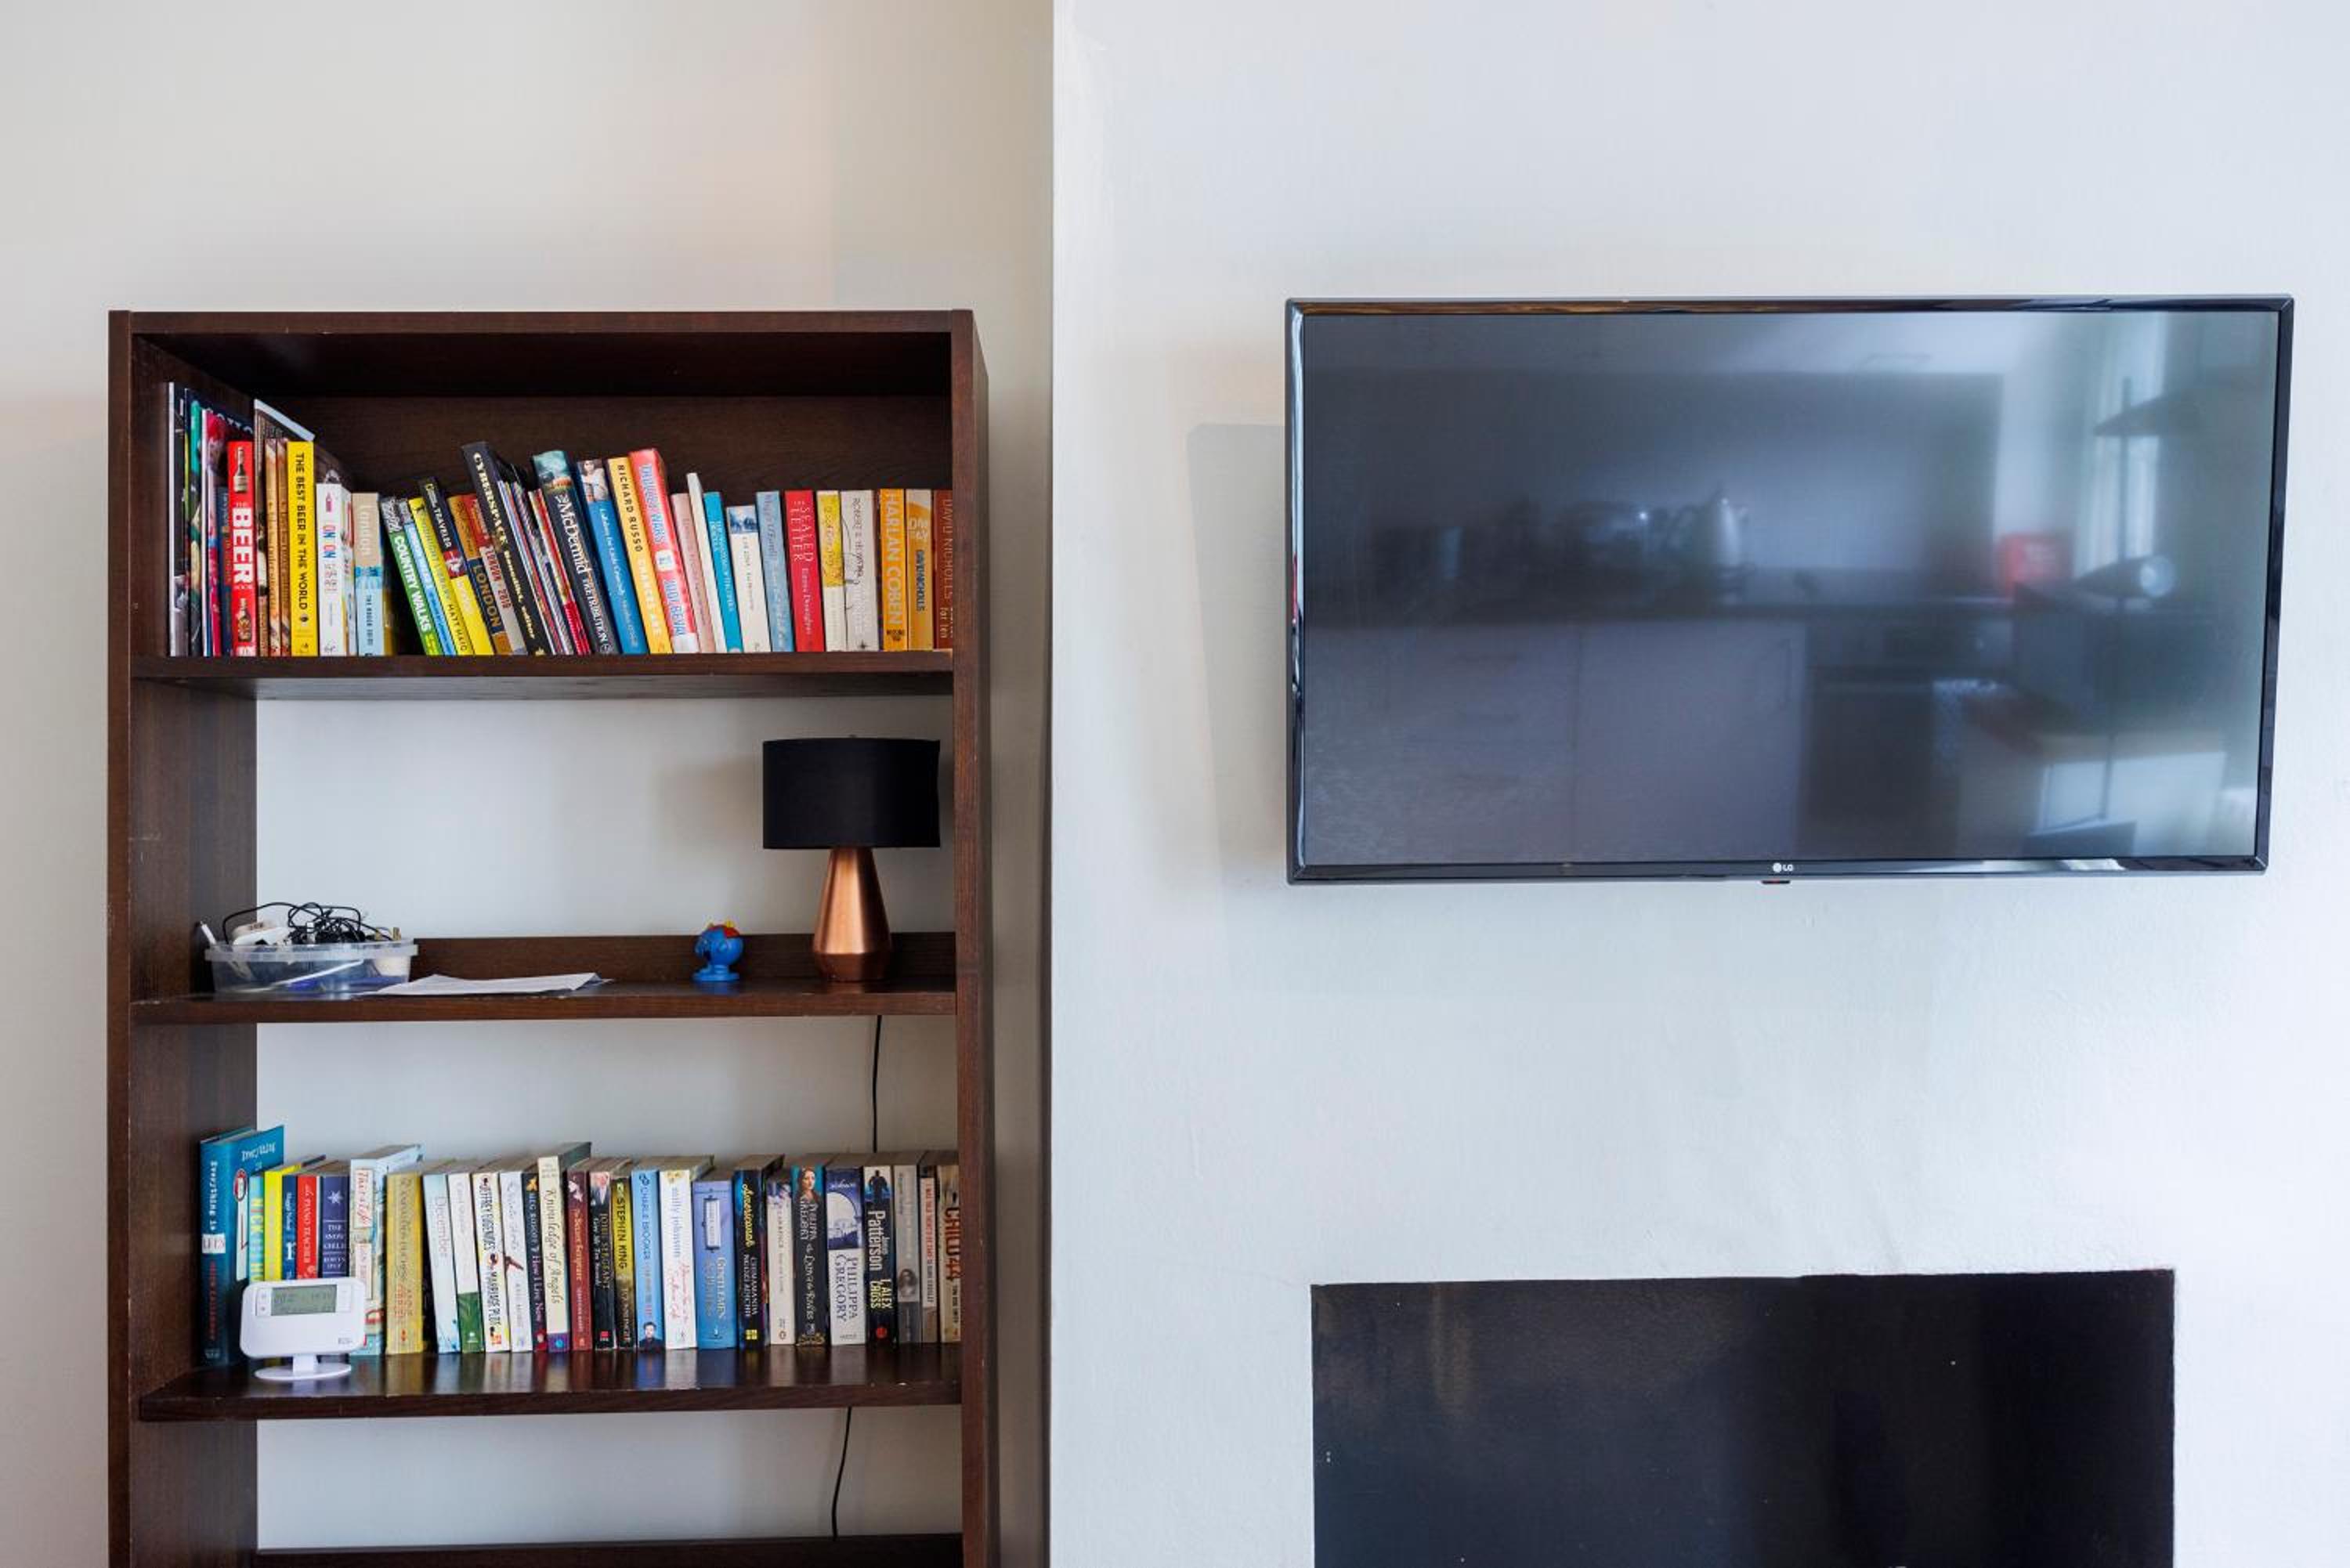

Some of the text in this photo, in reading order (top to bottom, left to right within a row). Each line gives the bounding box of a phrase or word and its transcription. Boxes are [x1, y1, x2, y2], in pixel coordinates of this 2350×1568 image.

[434, 508, 452, 549] TRAVELER
[473, 452, 508, 546] CYBERSPACE
[617, 464, 634, 513] RICHARD
[629, 516, 643, 553] RUSSO
[885, 493, 903, 562] HARLAN
[233, 508, 254, 583] BEER
[295, 453, 309, 610] THE BEST BEER IN THE WORLD
[556, 502, 592, 574] McDermid
[790, 508, 804, 562] LETTER
[801, 506, 814, 562] SEALED
[942, 498, 953, 600] DAVID NICHOLLS
[395, 535, 417, 590] COUNTRY
[412, 591, 432, 632] WALKS
[473, 565, 501, 628] LONDON
[887, 565, 903, 625] COBEN
[447, 604, 460, 627] MATT
[456, 628, 468, 651] HAIG
[208, 1160, 219, 1231] Everything is
[303, 1198, 312, 1226] PIANO
[479, 1183, 496, 1251] JEFFREY EUGENIDES
[544, 1189, 559, 1248] Knowledge
[640, 1185, 649, 1220] CHARLIE
[741, 1183, 754, 1248] Americanah
[799, 1194, 809, 1241] GREGORY
[808, 1202, 819, 1241] PHILIPPA
[303, 1227, 313, 1263] TEACHER
[434, 1195, 450, 1259] December
[616, 1198, 628, 1270] STEPHEN KING
[642, 1221, 651, 1260] BROOKER
[671, 1215, 683, 1259] johnson
[867, 1210, 888, 1271] Patterson
[881, 1236, 891, 1255] James
[943, 1206, 962, 1282] CHILD 44
[547, 1268, 562, 1304] Angels
[548, 1252, 562, 1264] of
[573, 1244, 584, 1282] Scripture
[601, 1241, 610, 1290] SERGEANT
[750, 1256, 758, 1315] CHIMAMANDA
[834, 1253, 848, 1322] GREGORY
[533, 1282, 542, 1300] Live
[846, 1256, 859, 1320] PHILIPPA
[870, 1280, 882, 1310] CROSS
[881, 1286, 892, 1310] ALEX
